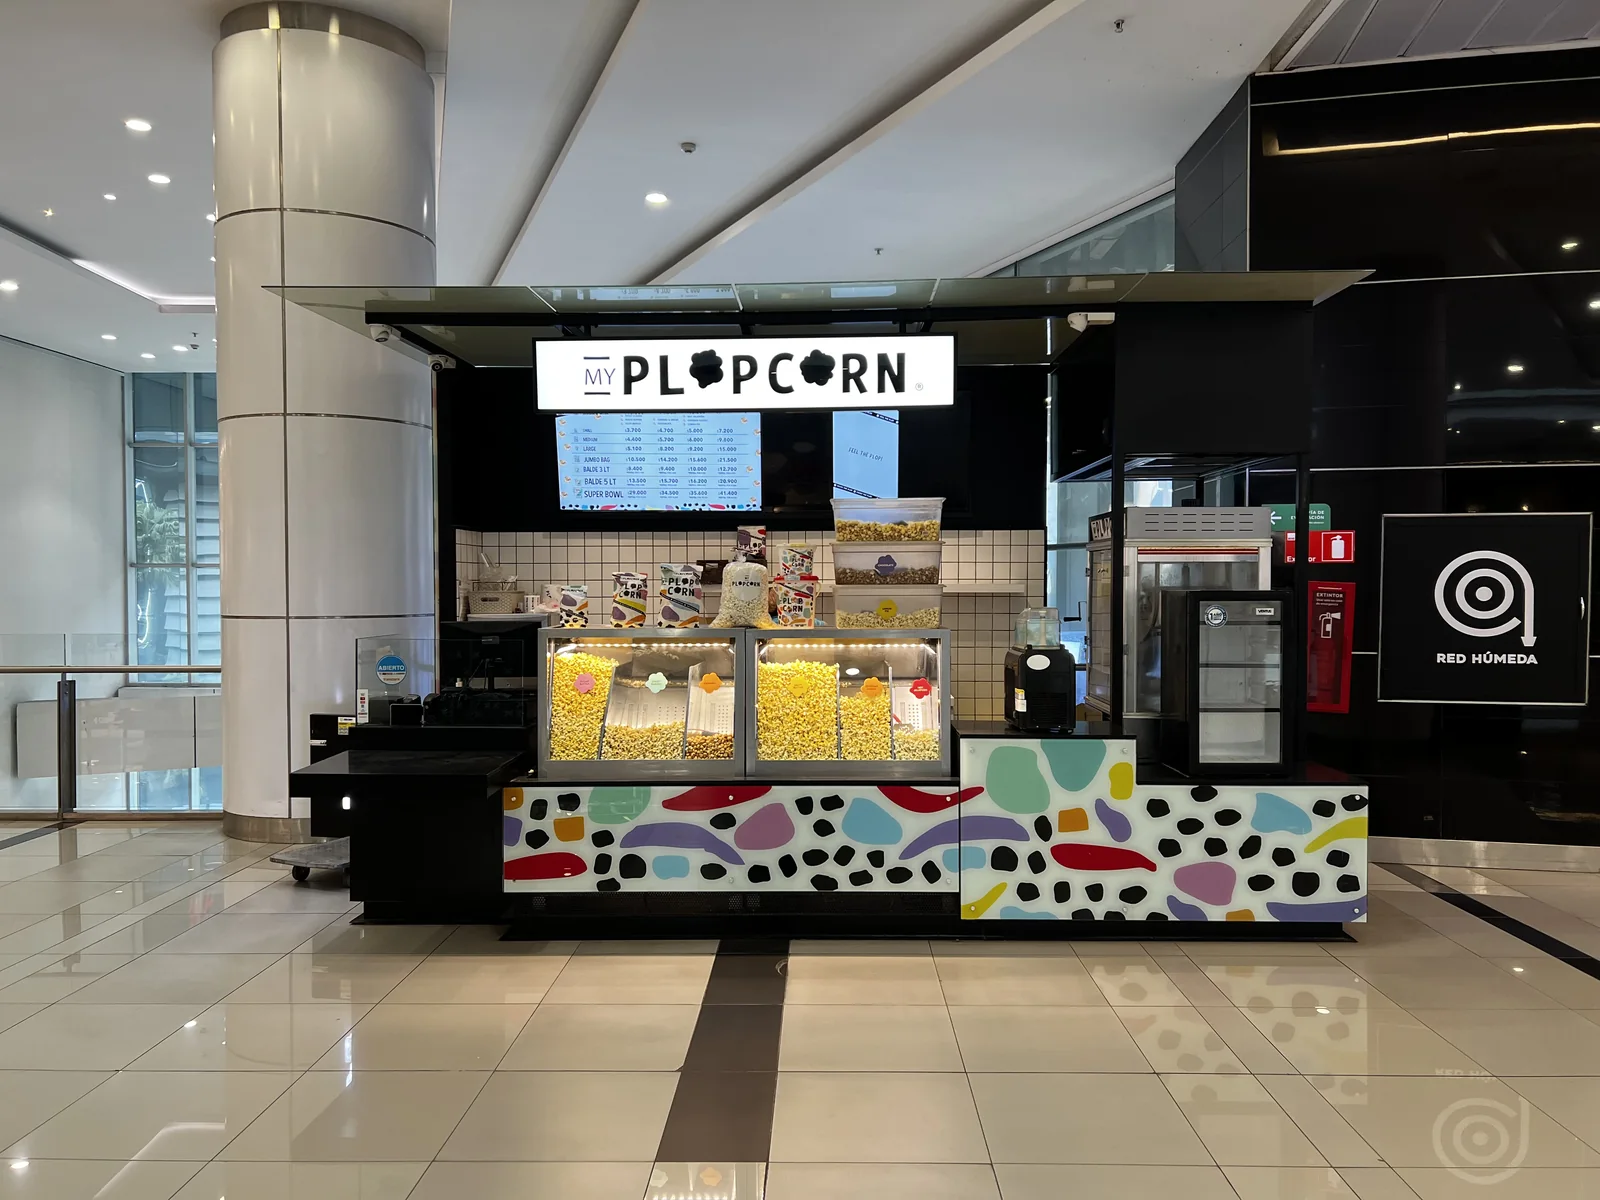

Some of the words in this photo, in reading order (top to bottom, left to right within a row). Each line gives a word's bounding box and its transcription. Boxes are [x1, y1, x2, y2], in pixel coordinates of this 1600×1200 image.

[585, 368, 615, 385] MY
[623, 349, 905, 395] PLOPCORN
[848, 447, 859, 455] FEEL
[860, 450, 869, 458] THE
[584, 490, 604, 498] SUPER
[605, 490, 624, 498] BOWL
[668, 578, 694, 587] PLOP
[619, 590, 642, 599] CORN
[668, 586, 695, 597] CORN
[1437, 653, 1466, 664] RED
[1471, 651, 1538, 664] HÚMEDA
